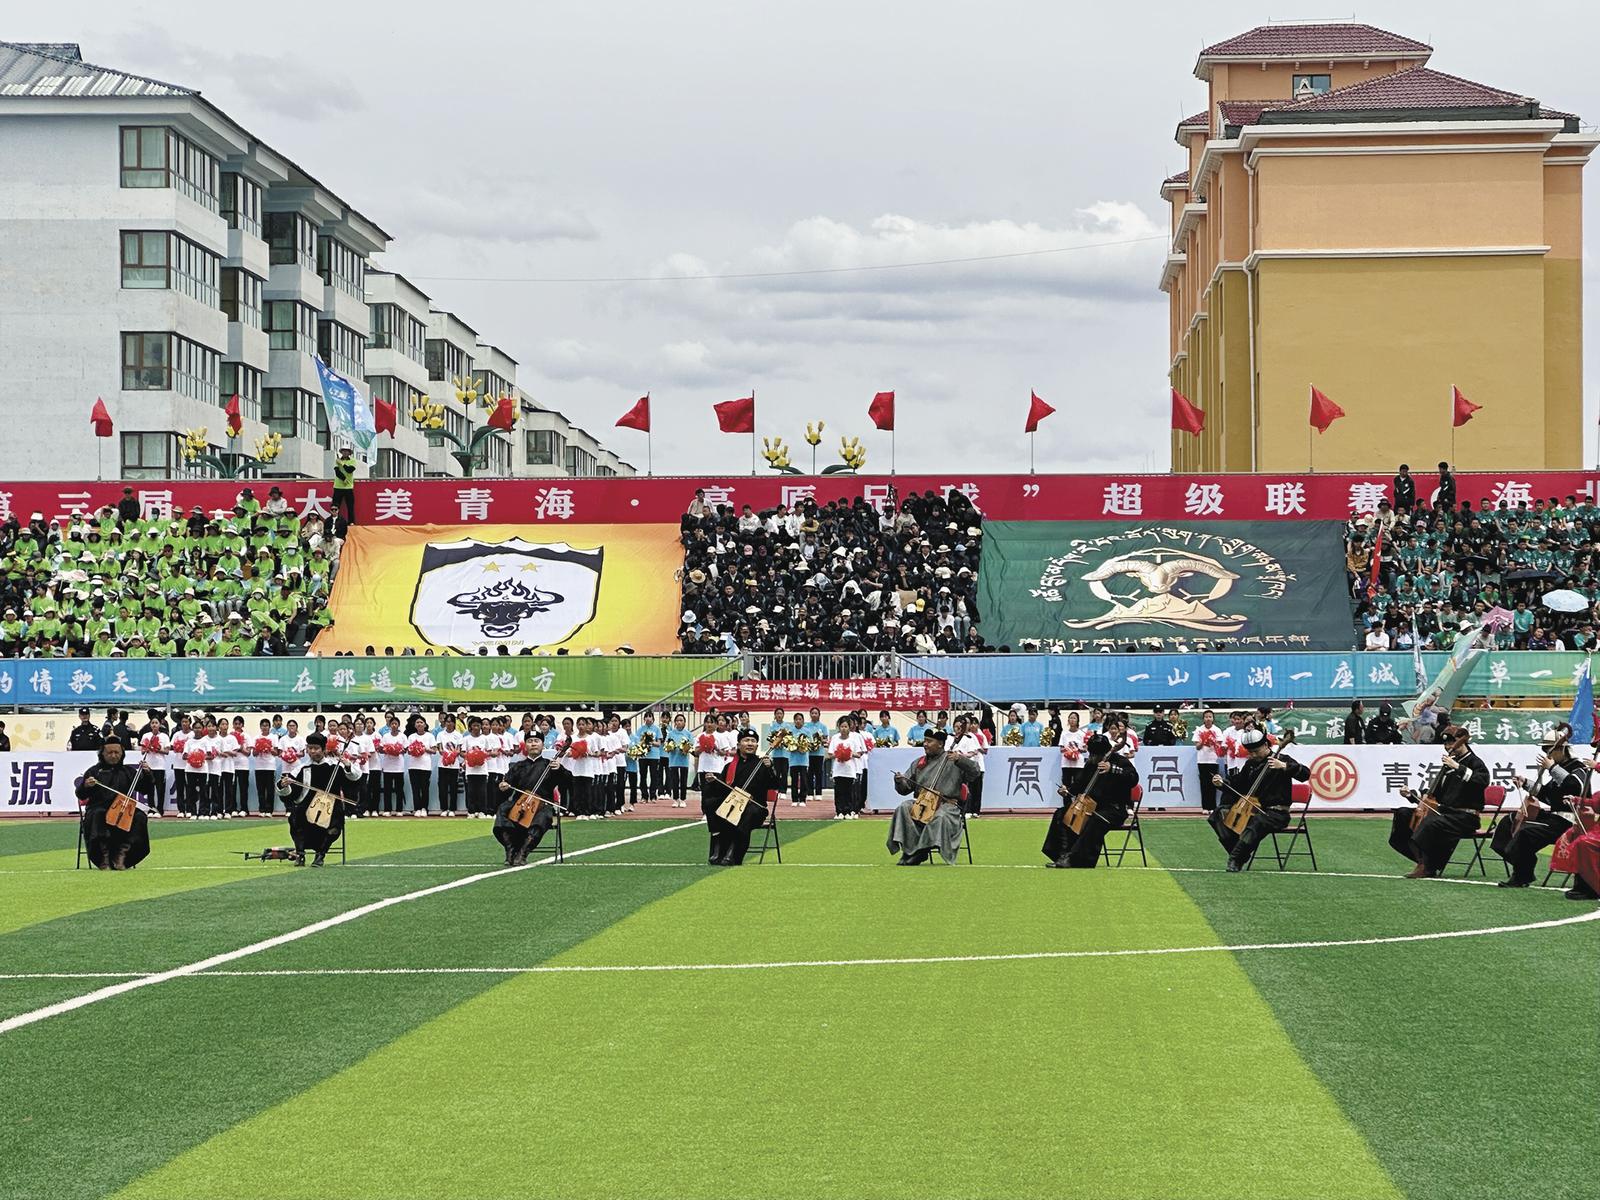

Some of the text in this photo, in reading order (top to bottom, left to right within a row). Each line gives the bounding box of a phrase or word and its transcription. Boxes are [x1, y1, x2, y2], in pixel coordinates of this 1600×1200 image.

[706, 680, 943, 701] 大美青海燃赛场 海北藏羊展锋芒
[8, 761, 54, 806] 源
